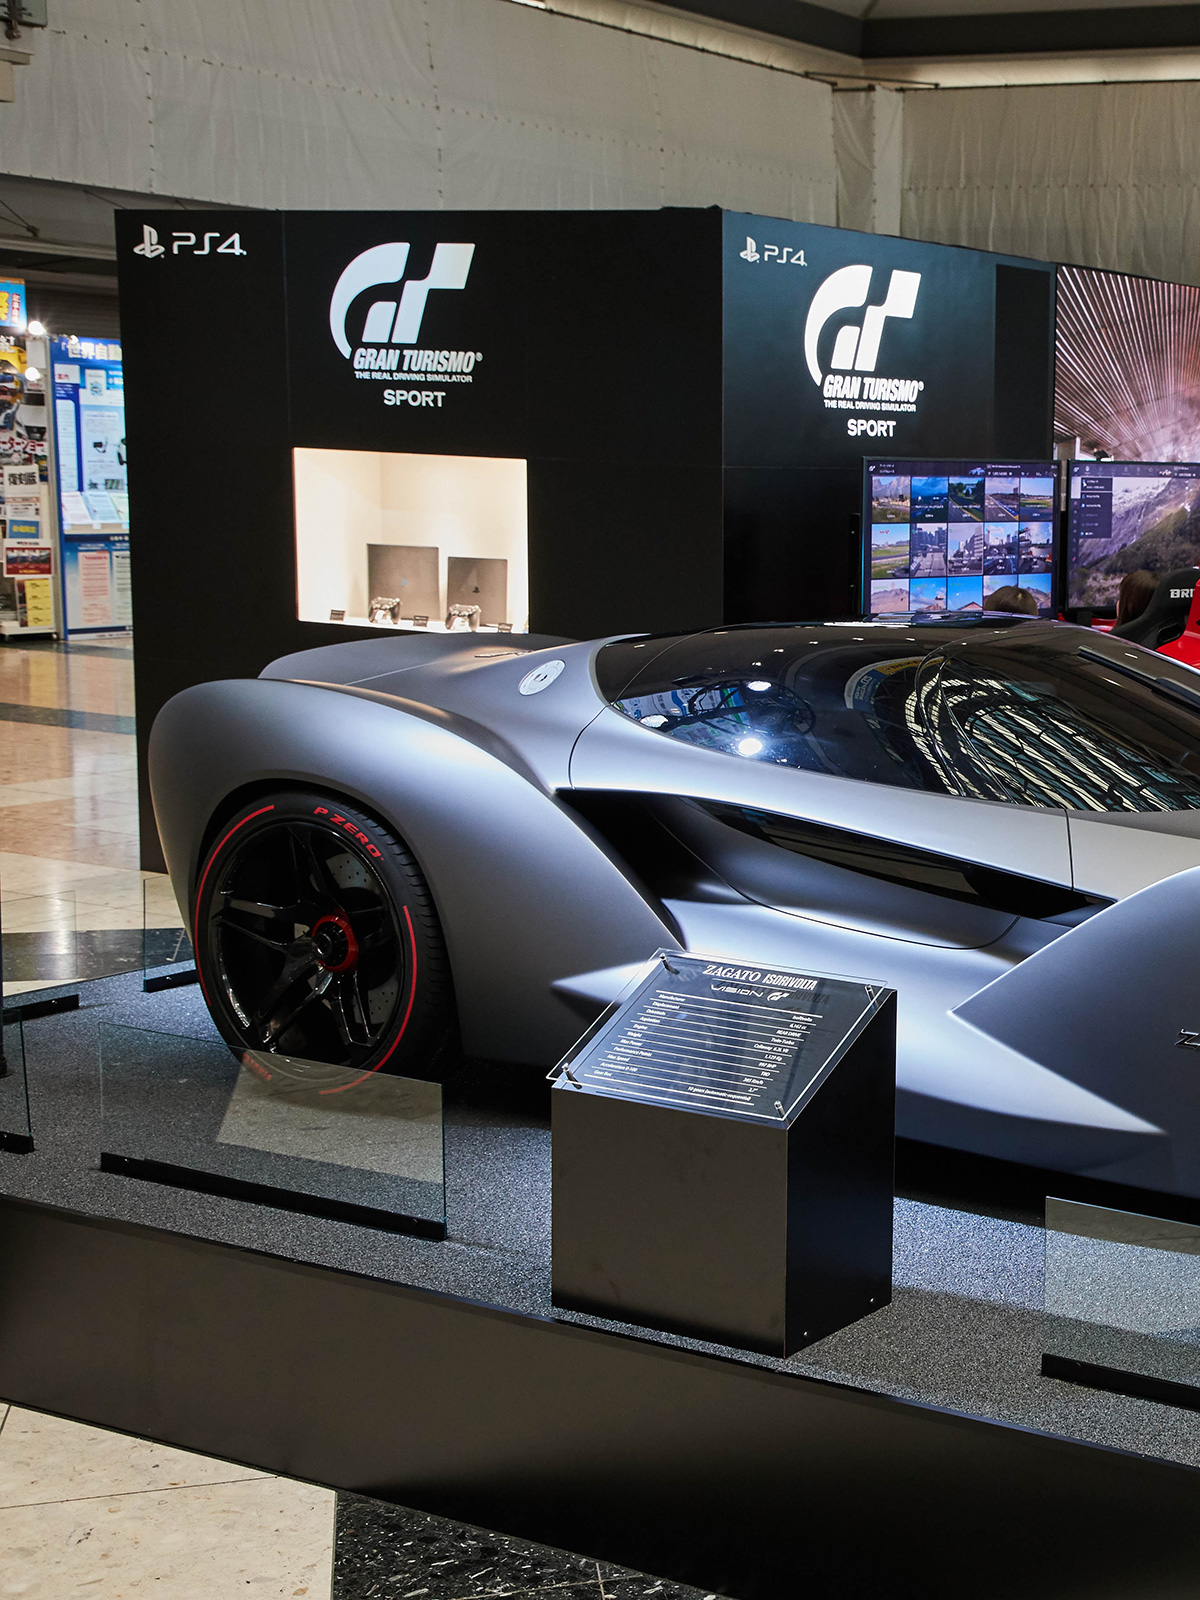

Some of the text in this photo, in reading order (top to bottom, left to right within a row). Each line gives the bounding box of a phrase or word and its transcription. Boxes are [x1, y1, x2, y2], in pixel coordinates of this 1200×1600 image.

[172, 232, 247, 256] PS4
[764, 244, 808, 267] PS4
[353, 347, 400, 370] GRAN
[354, 371, 473, 383] THE REAL DRIVING SIMULATOR
[823, 374, 861, 399] GRAN
[383, 389, 446, 407] SPORT
[824, 399, 917, 412] THE REAL DRIVING SIMULATOR
[847, 419, 897, 437] SPORT
[1170, 588, 1195, 599] BRI
[313, 807, 382, 858] P ZERO
[702, 964, 818, 991] ZAGATO ISORIVOLTA
[711, 983, 764, 998] VISION
